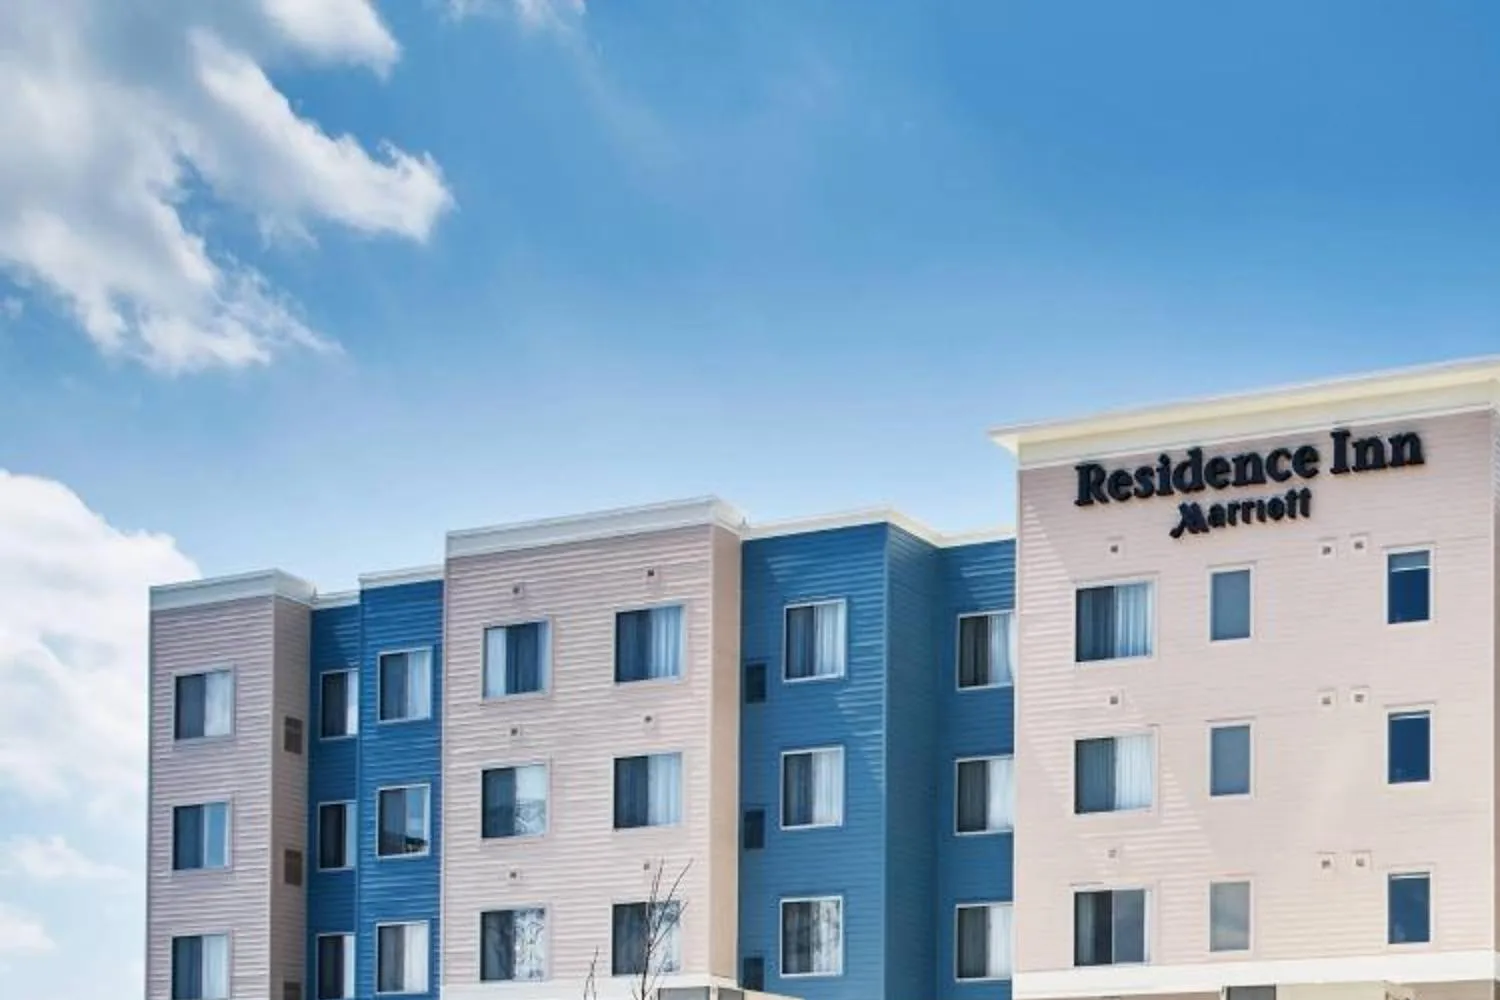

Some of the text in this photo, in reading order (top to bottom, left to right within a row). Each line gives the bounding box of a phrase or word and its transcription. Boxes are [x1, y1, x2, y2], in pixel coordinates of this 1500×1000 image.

[1074, 427, 1425, 507] Residence Inn
[1169, 486, 1312, 539] Marriott
